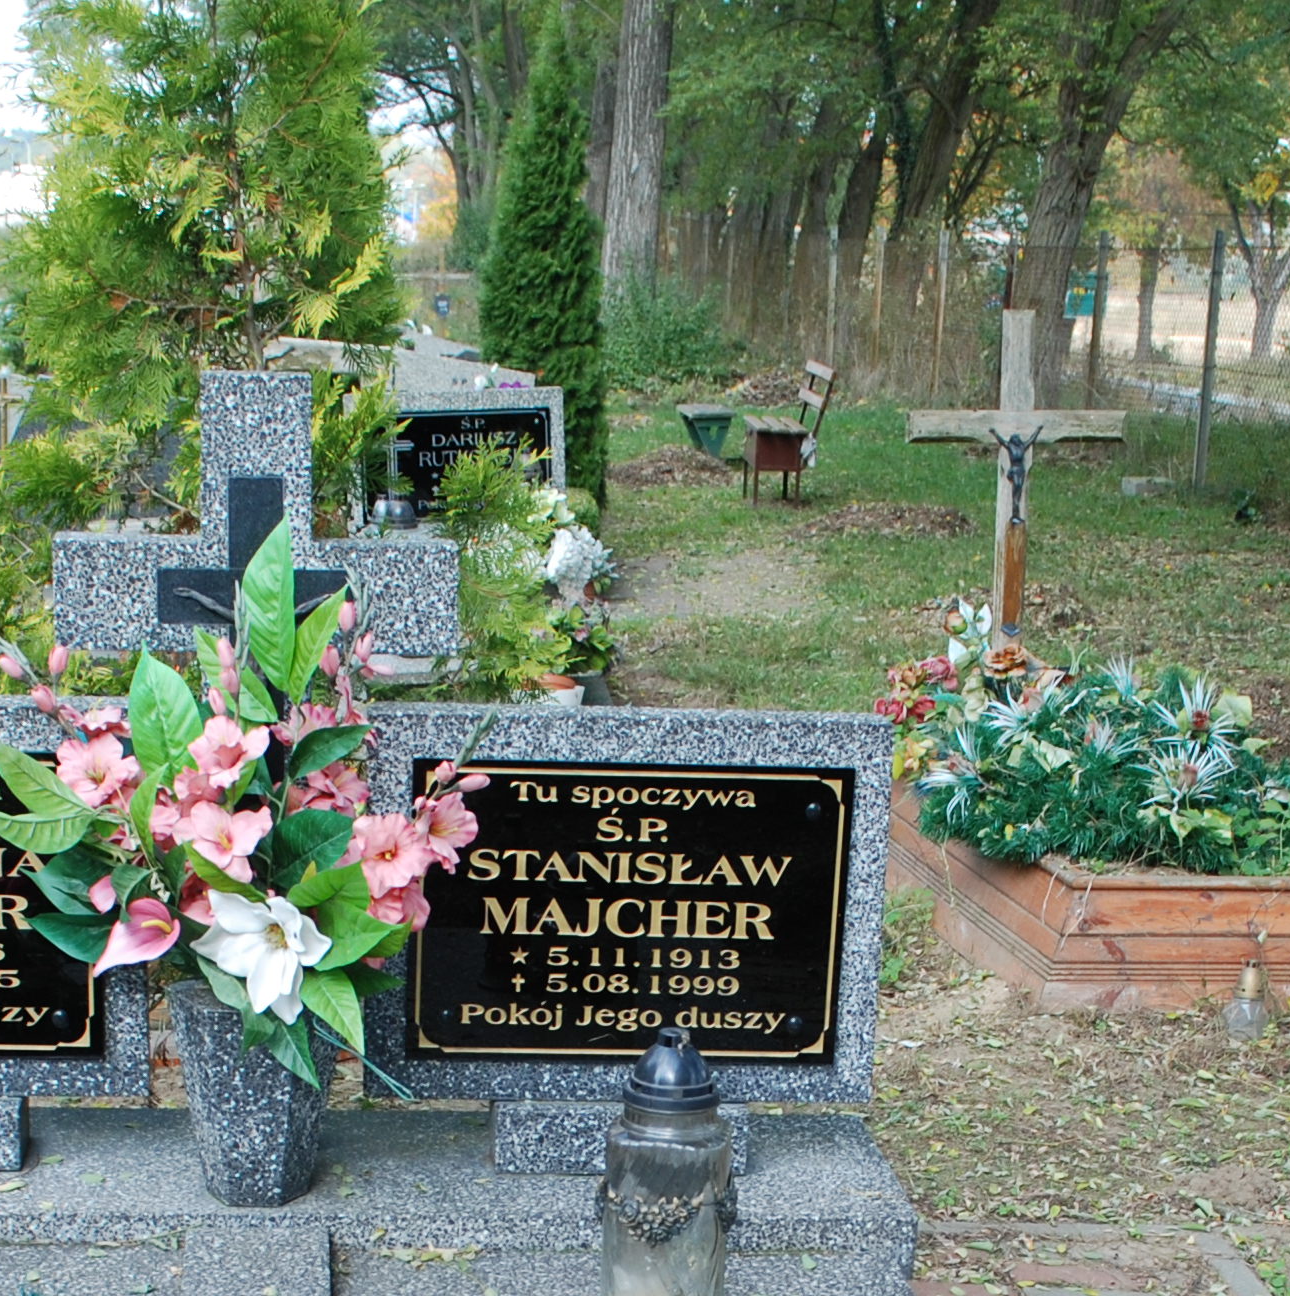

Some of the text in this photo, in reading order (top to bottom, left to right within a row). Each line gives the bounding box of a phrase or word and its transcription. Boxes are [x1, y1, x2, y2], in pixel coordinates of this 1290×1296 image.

[431, 431, 517, 448] DARIUSZ
[509, 780, 757, 812] Tu spoczywa
[595, 808, 669, 843] Ś.P.
[466, 848, 793, 887] STANISŁAW
[479, 896, 776, 941] MAJCHER
[545, 946, 742, 970] 5.11.1913
[545, 973, 741, 997] 5.08.1999
[459, 1001, 786, 1034] Pokój Jego duszy
